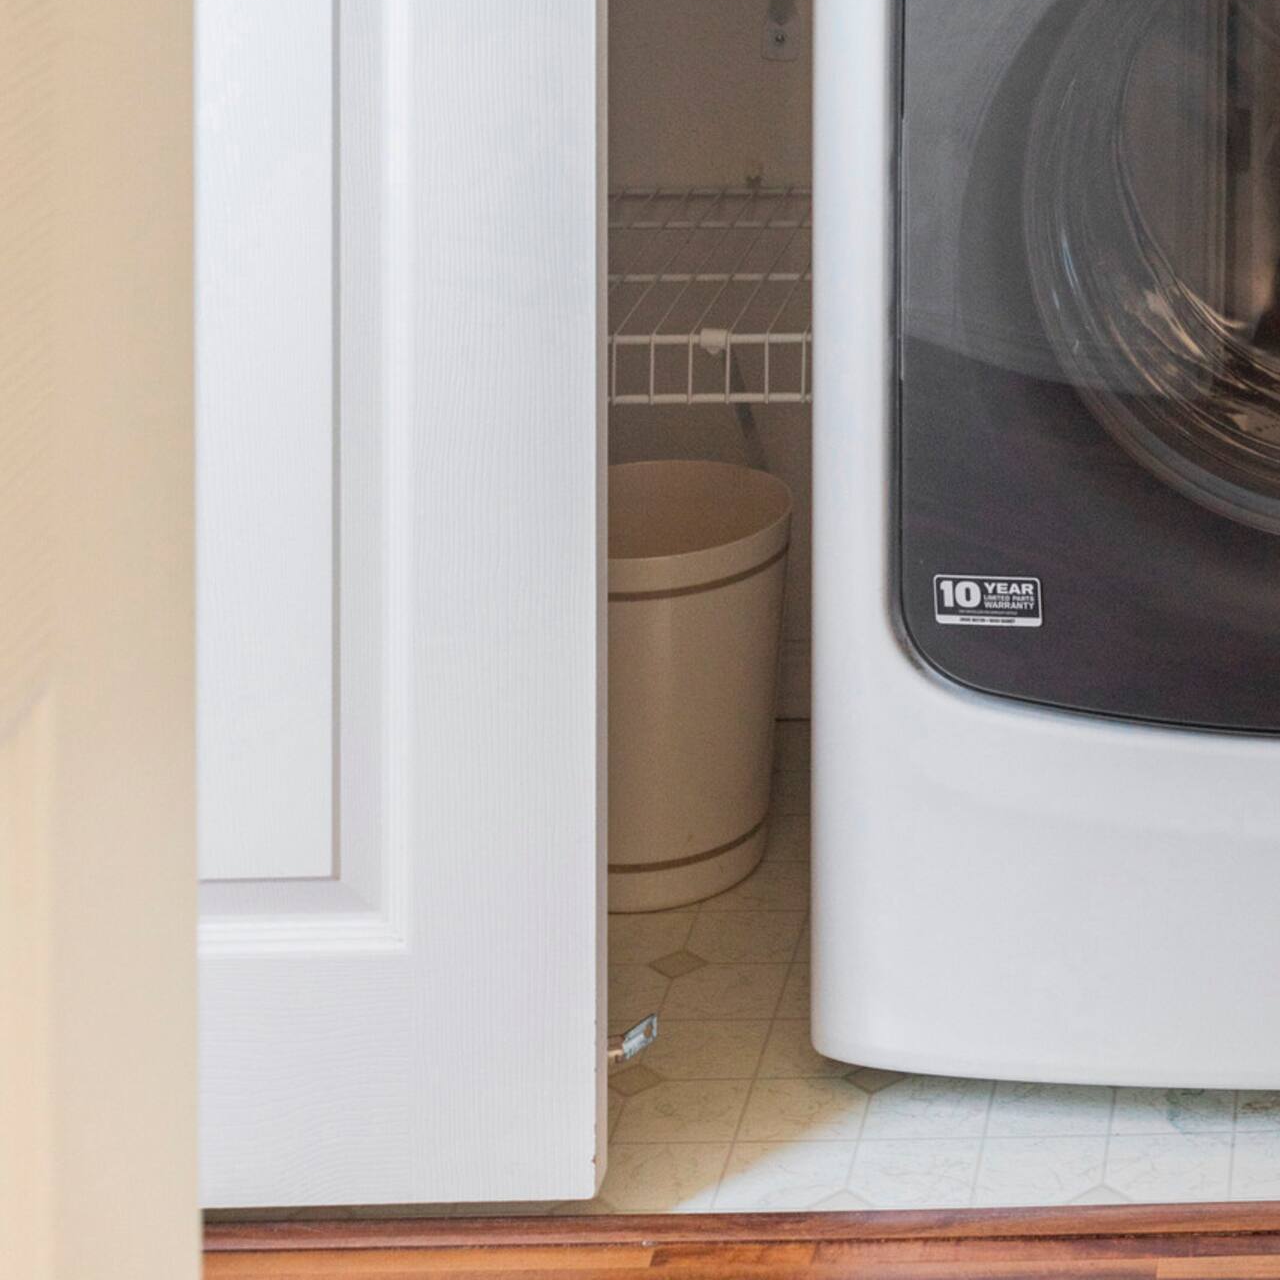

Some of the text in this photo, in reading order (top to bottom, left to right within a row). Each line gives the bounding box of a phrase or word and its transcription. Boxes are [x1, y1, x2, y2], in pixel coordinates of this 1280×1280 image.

[940, 580, 981, 608] 10
[984, 582, 1034, 595] YEAR
[984, 601, 1034, 610] WARRANTY
